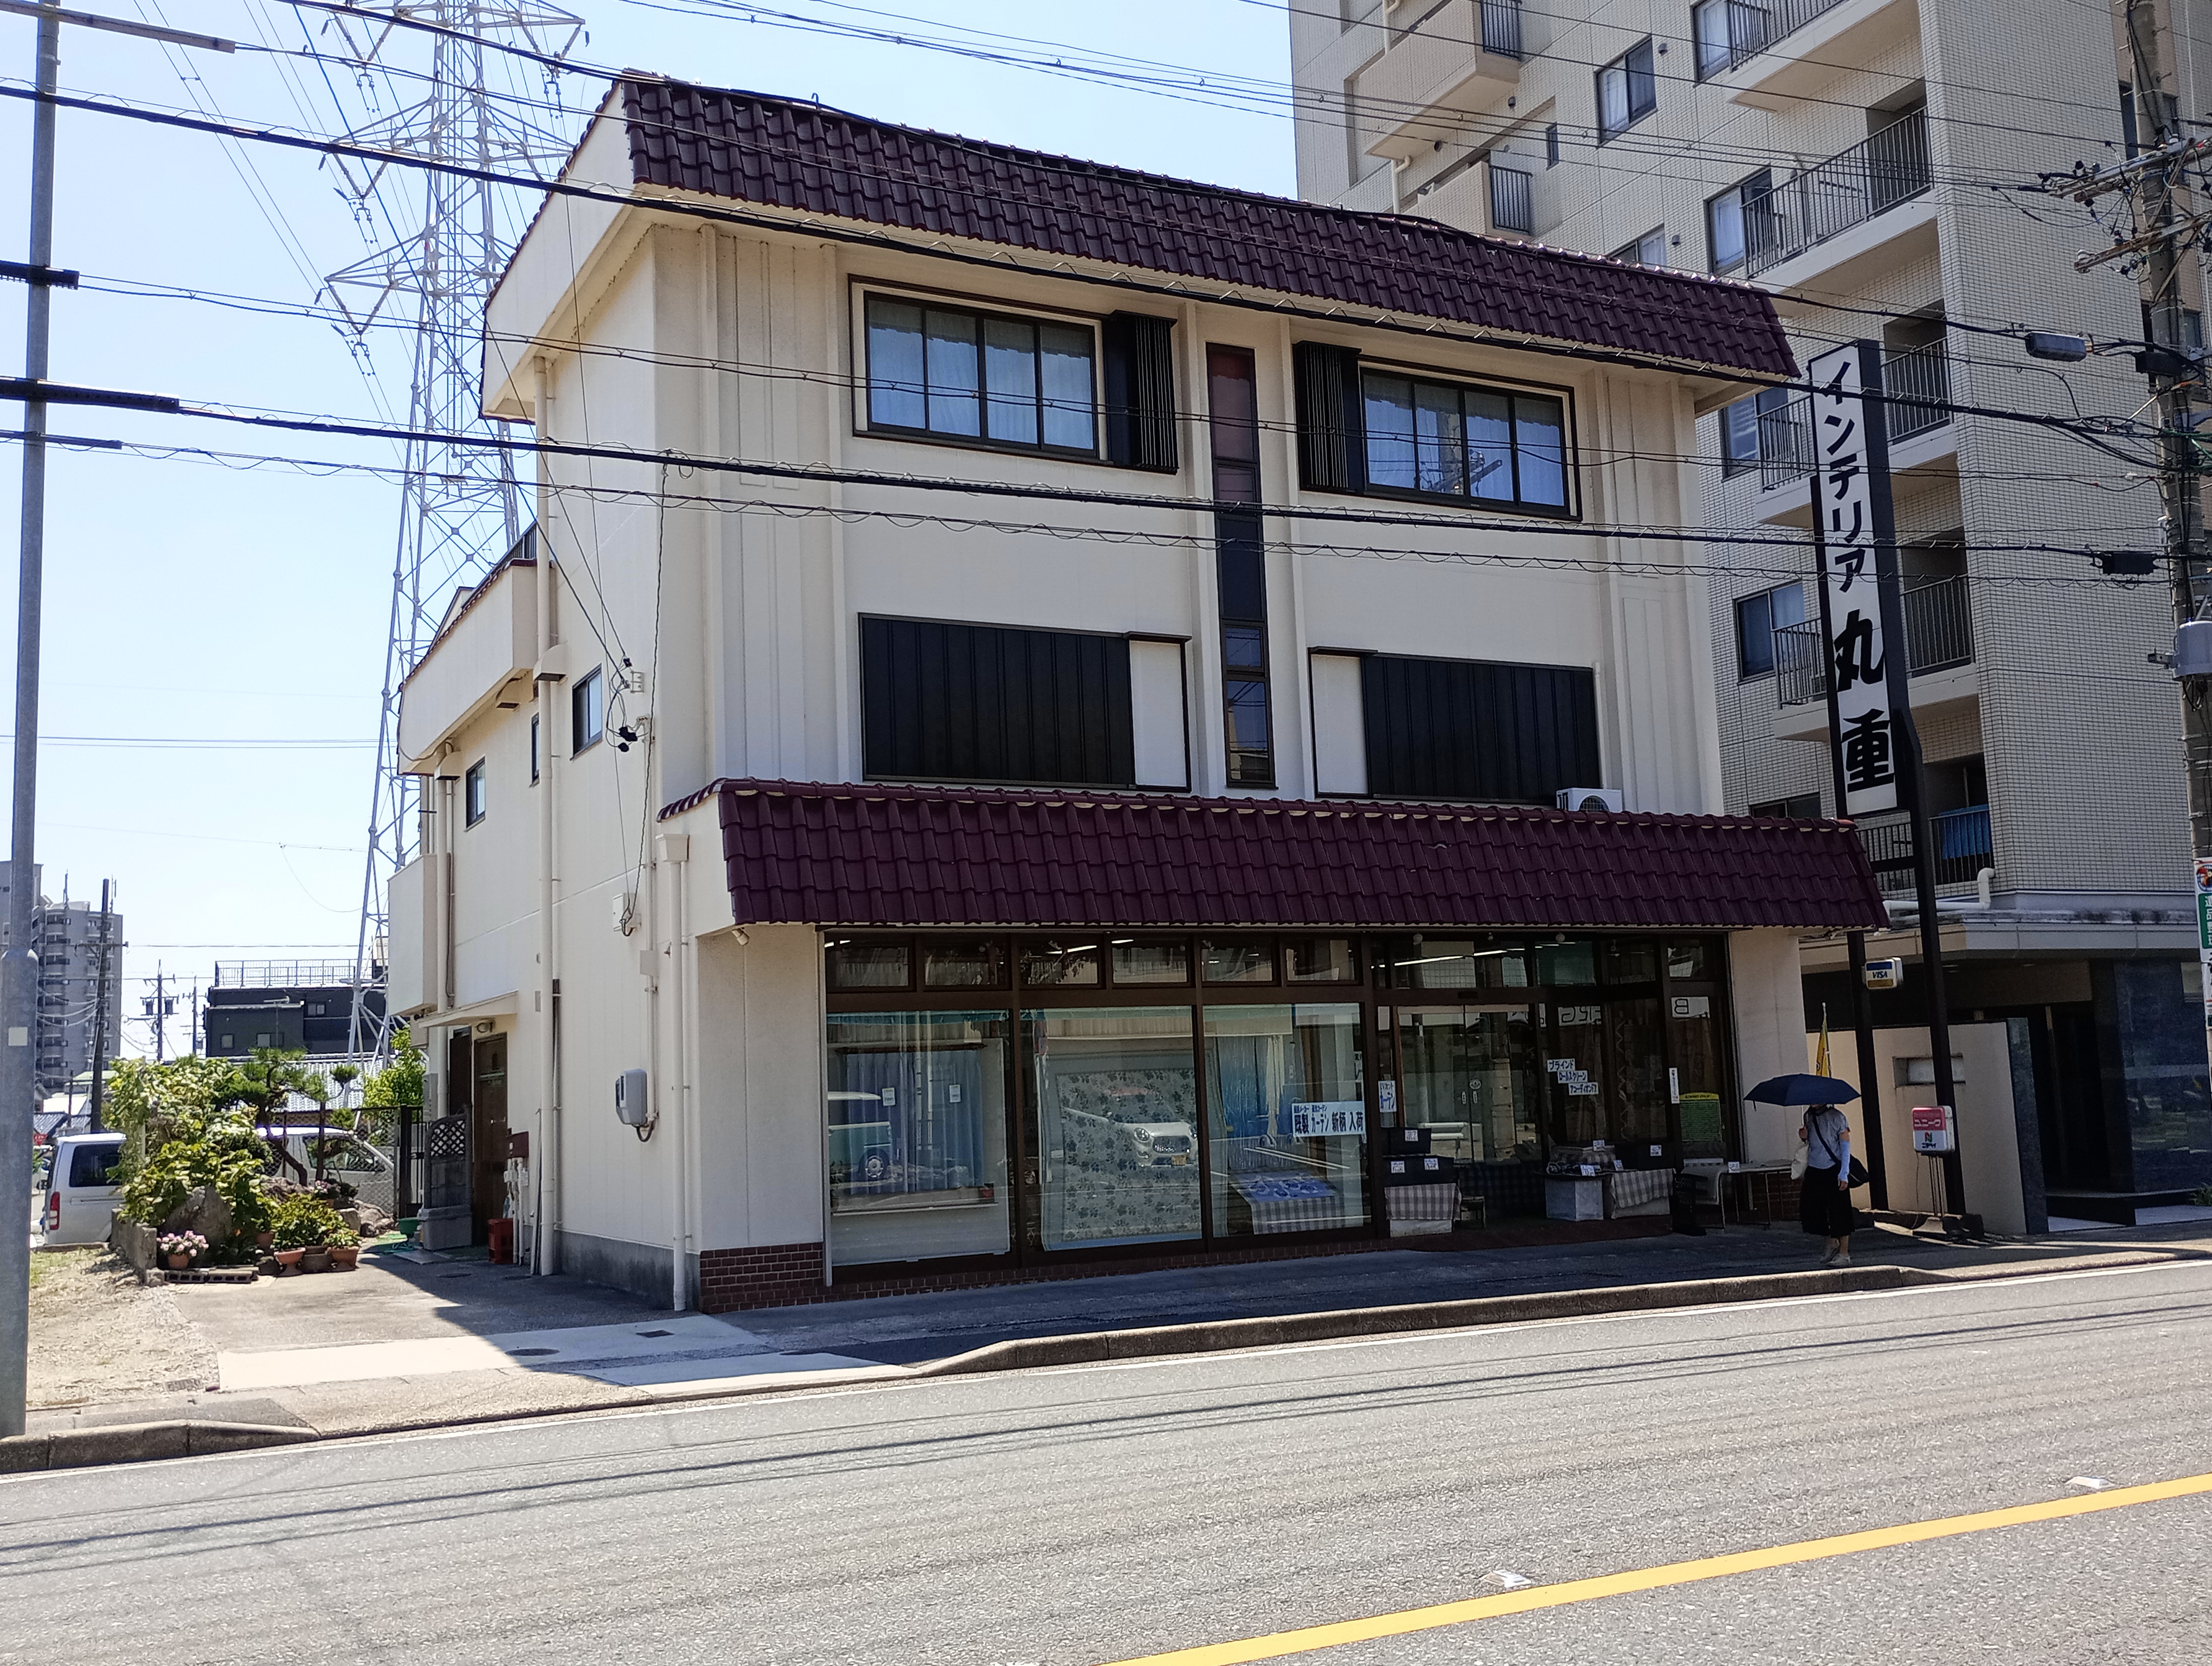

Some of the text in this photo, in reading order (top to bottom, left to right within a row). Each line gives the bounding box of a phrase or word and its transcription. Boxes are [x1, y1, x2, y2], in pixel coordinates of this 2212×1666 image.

[1872, 971, 1888, 979] VISA
[1311, 1113, 1329, 1133] カーテン
[1332, 1111, 1347, 1132] 新柄
[1349, 1111, 1364, 1132] 入荷
[1914, 1119, 1941, 1127] ユニーク
